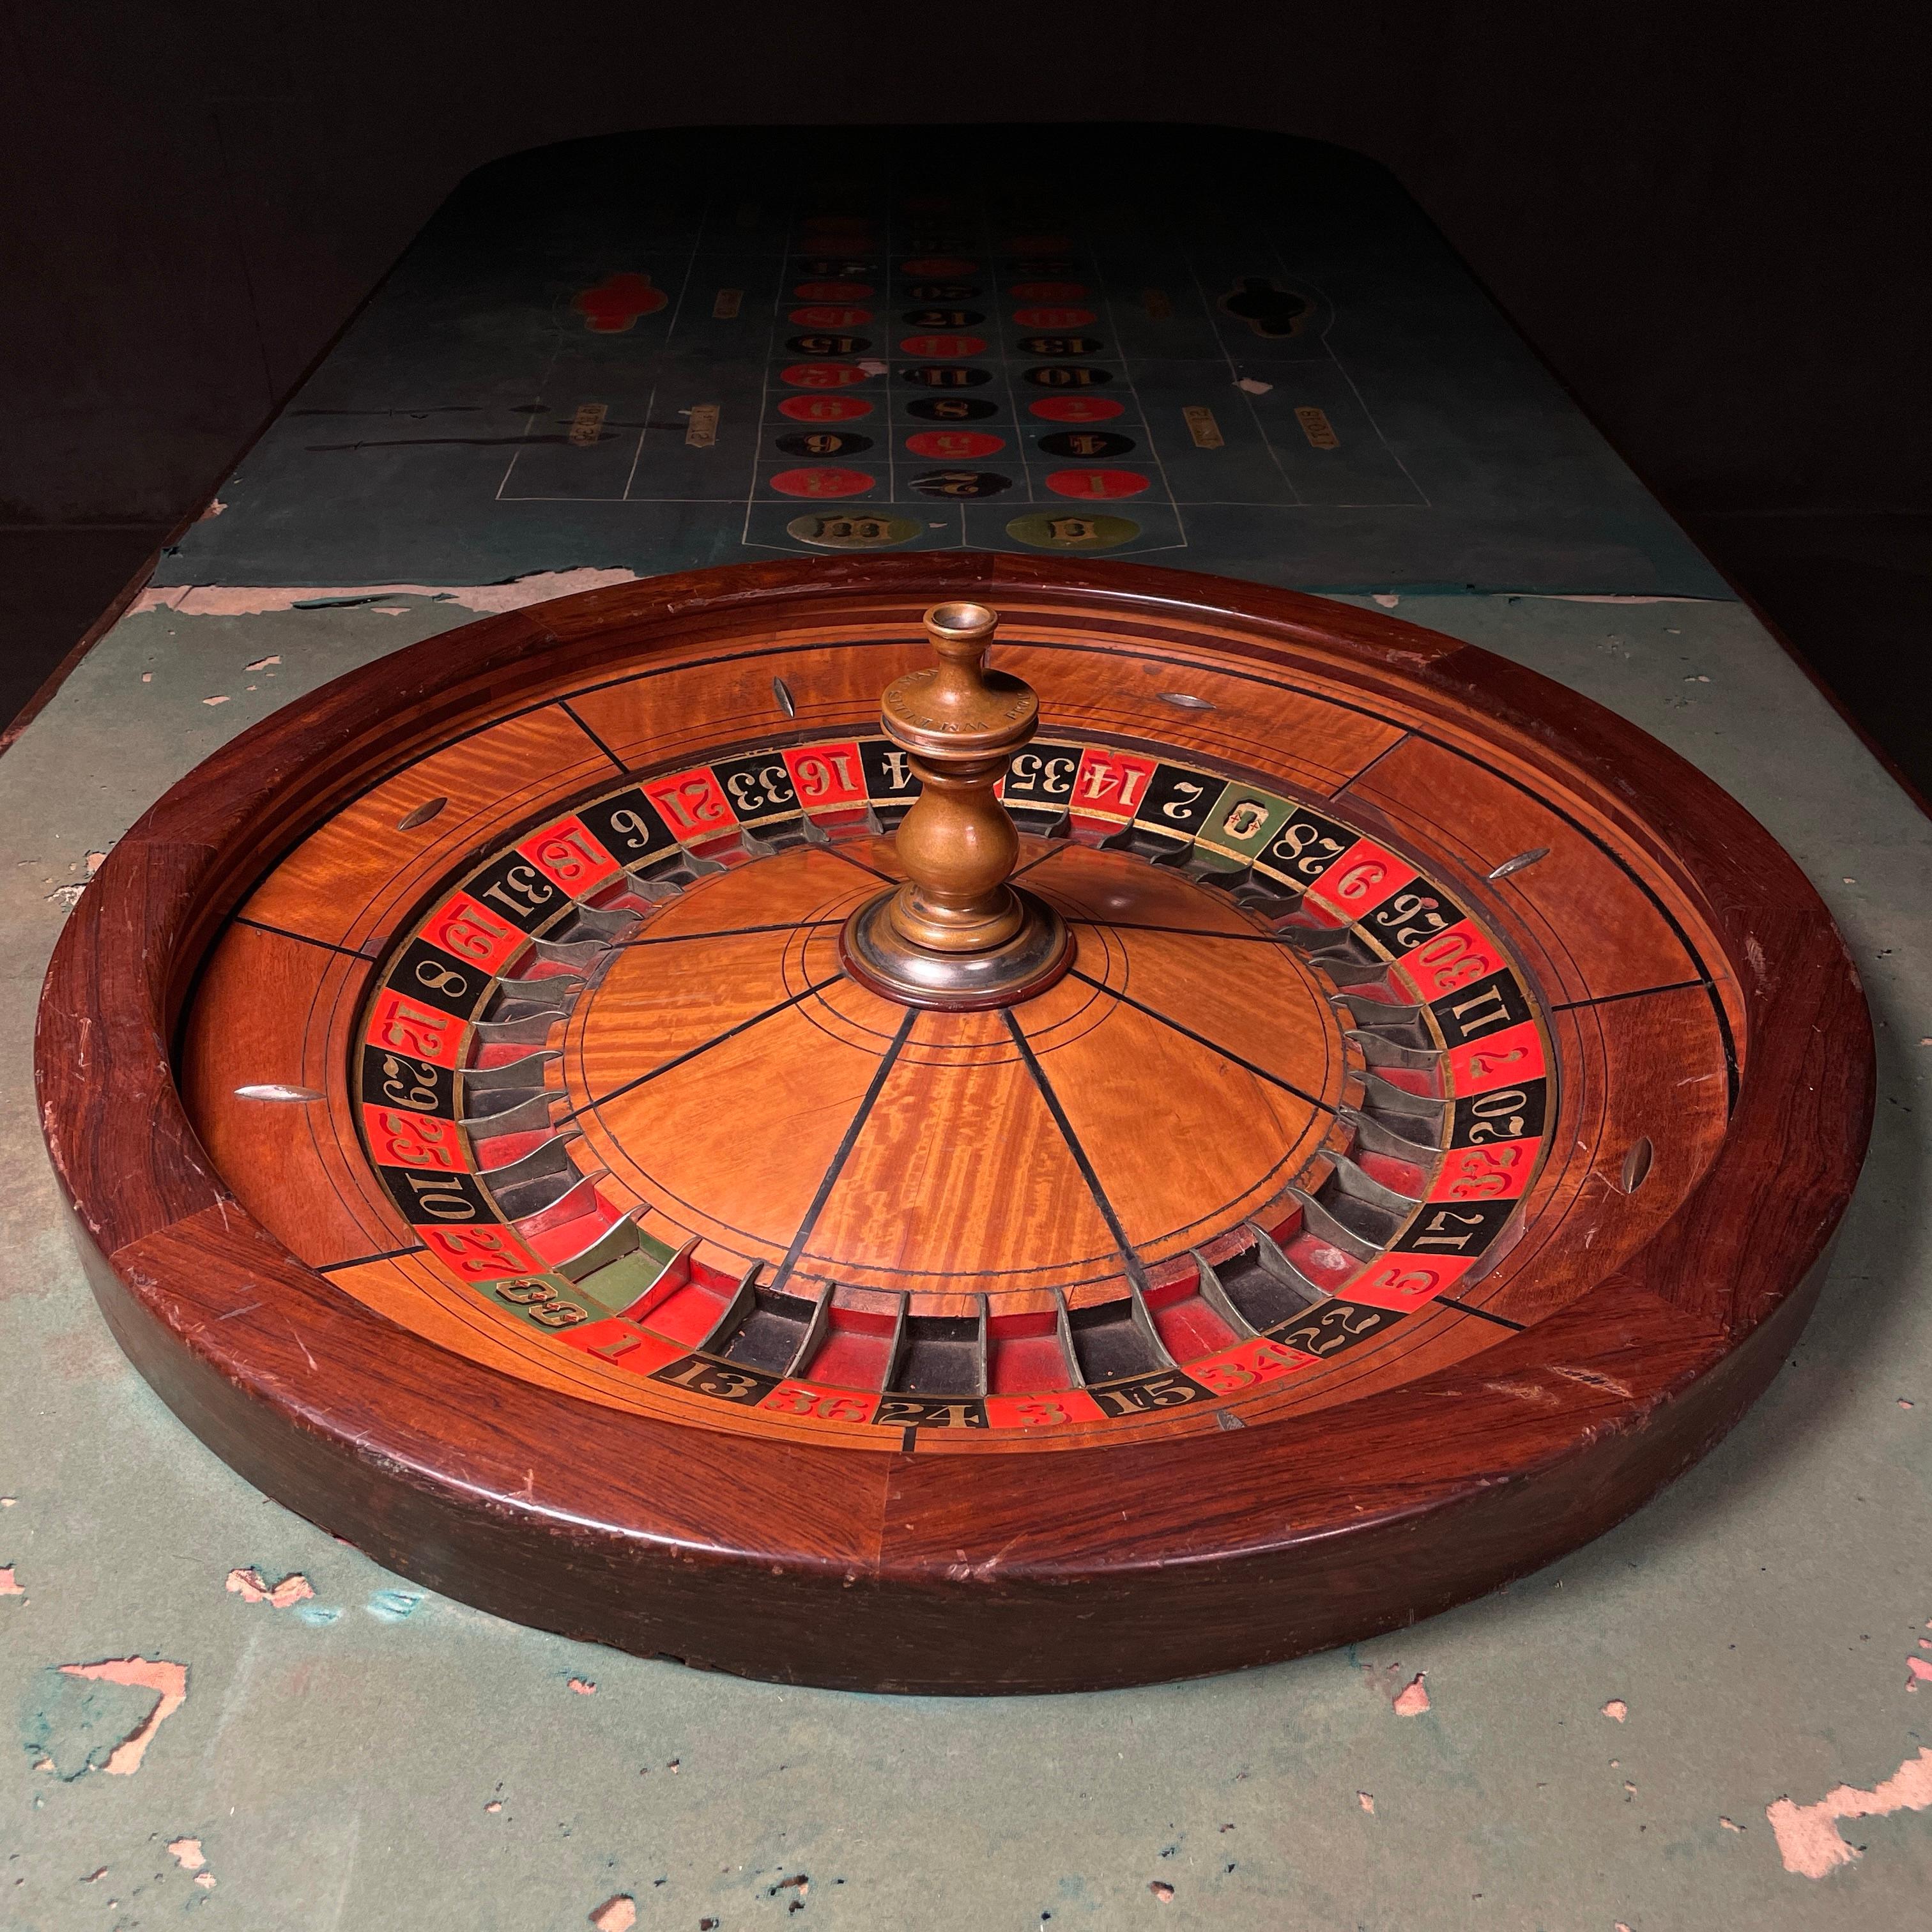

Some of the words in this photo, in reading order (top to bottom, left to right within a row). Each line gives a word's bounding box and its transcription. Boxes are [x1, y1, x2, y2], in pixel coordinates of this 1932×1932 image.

[801, 337, 855, 355] 15
[1031, 336, 1084, 355] 13
[926, 366, 967, 388] 11
[1038, 366, 1092, 388] 10
[805, 433, 843, 453] 6
[1067, 433, 1108, 454] 4
[940, 472, 980, 494] 2
[726, 765, 794, 811] 33
[799, 750, 858, 794] 16
[882, 752, 909, 790] 4
[1011, 754, 1077, 793] 35
[1083, 762, 1146, 806] 14
[651, 779, 724, 828] 21
[1163, 782, 1204, 818] 2
[610, 809, 649, 848] 6
[1223, 802, 1269, 840] 0
[537, 827, 606, 880] 18
[1273, 824, 1344, 875] 28
[484, 866, 552, 917] 31
[1338, 862, 1388, 898] 9
[440, 904, 509, 960] 19
[1377, 894, 1449, 948] 26
[415, 961, 467, 997] 8
[1418, 933, 1489, 989] 30
[384, 1002, 448, 1058] 12
[1452, 985, 1512, 1036] 11
[1471, 1047, 1528, 1077] 7
[383, 1054, 438, 1110] 29
[1469, 1090, 1526, 1144] 20
[382, 1112, 451, 1169] 25
[1448, 1145, 1522, 1199] 32
[404, 1173, 475, 1217] 10
[1413, 1212, 1485, 1250] 17
[433, 1228, 526, 1274] 27
[1373, 1268, 1440, 1296] 5
[495, 1279, 588, 1328] 00
[587, 1334, 641, 1364] 1
[1287, 1307, 1381, 1355] 22
[658, 1360, 756, 1399] 13
[1197, 1344, 1313, 1392] 34
[763, 1386, 868, 1423] 36
[877, 1404, 980, 1427] 24
[1021, 1404, 1071, 1426] 3
[1103, 1380, 1196, 1414] 15
